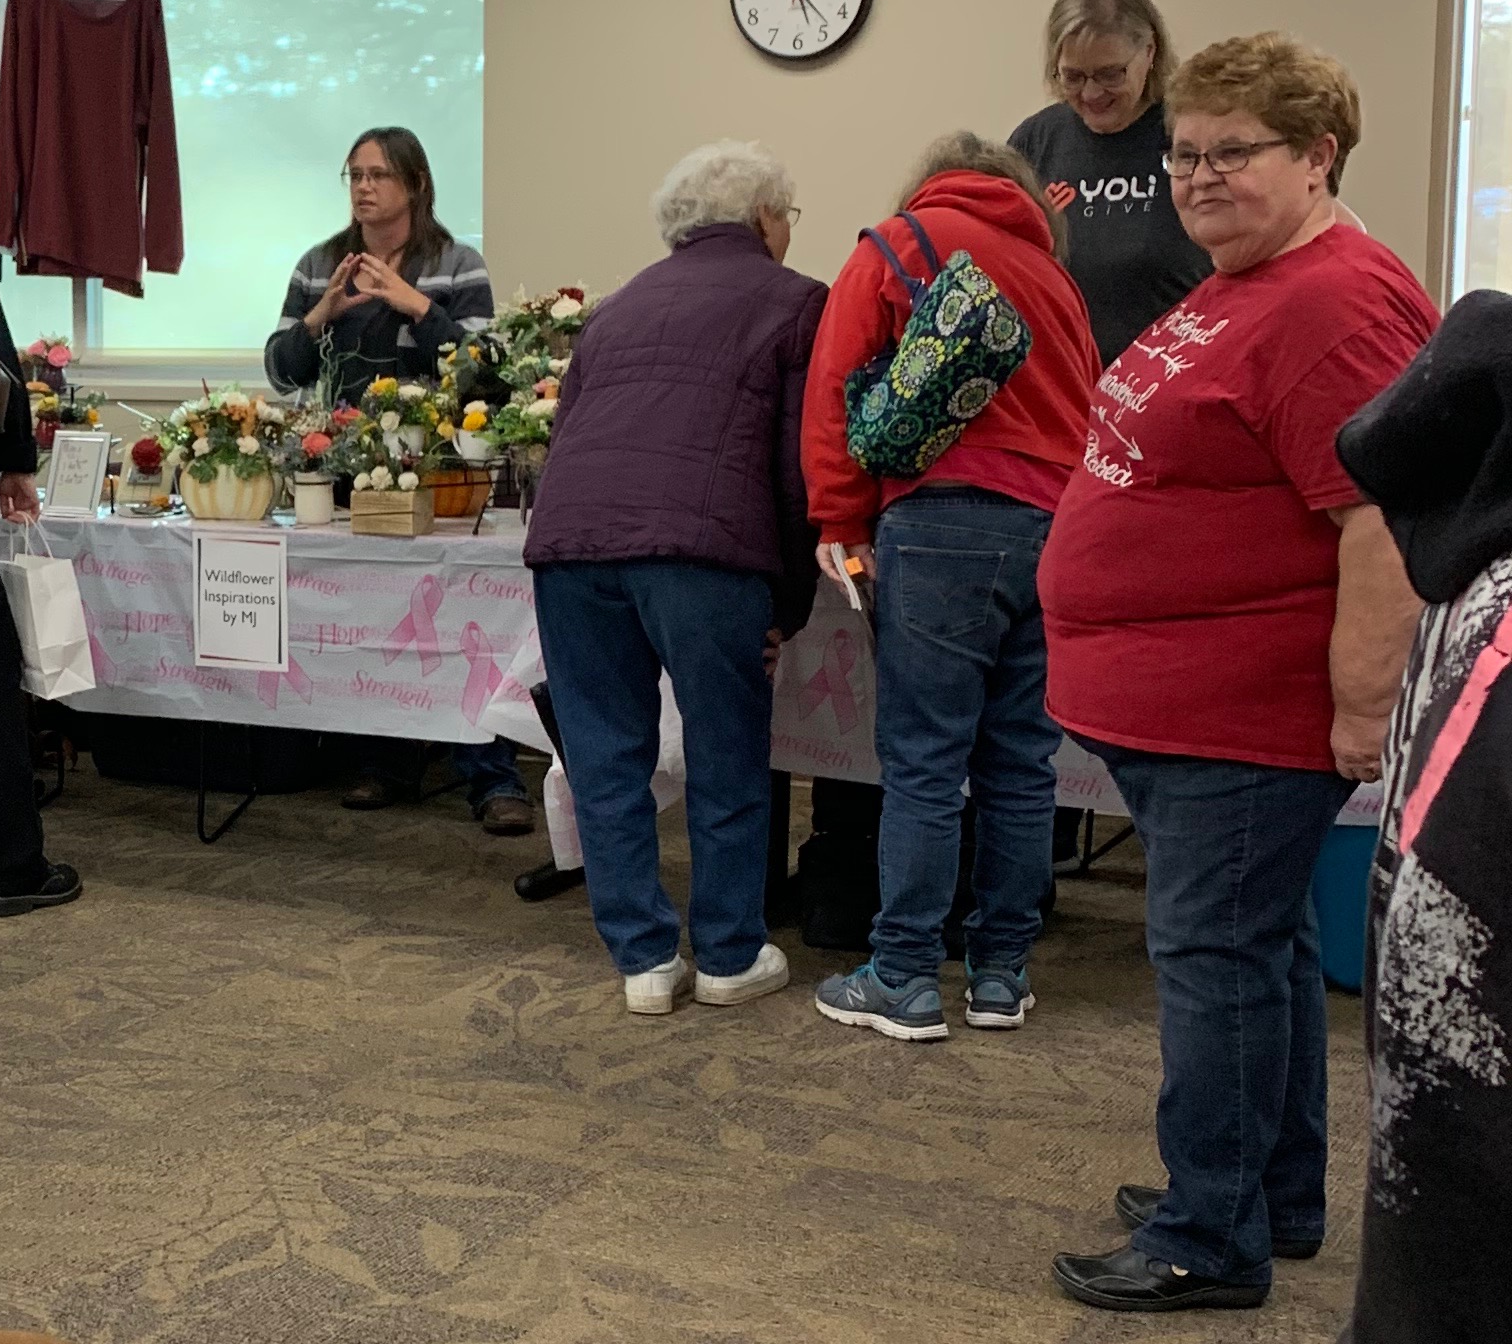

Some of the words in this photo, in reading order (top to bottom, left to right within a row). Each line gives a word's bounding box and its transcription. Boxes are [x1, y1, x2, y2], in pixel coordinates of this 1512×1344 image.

[747, 8, 758, 25] 8
[837, 2, 848, 19] 4
[768, 28, 779, 46] 7
[792, 32, 804, 50] 6
[817, 24, 828, 42] 5
[204, 569, 275, 586] Wildflower
[204, 590, 276, 607] Inspirations
[222, 611, 237, 626] by
[241, 610, 257, 627] MJ
[310, 622, 370, 656] Hope
[352, 669, 434, 711] Strength
